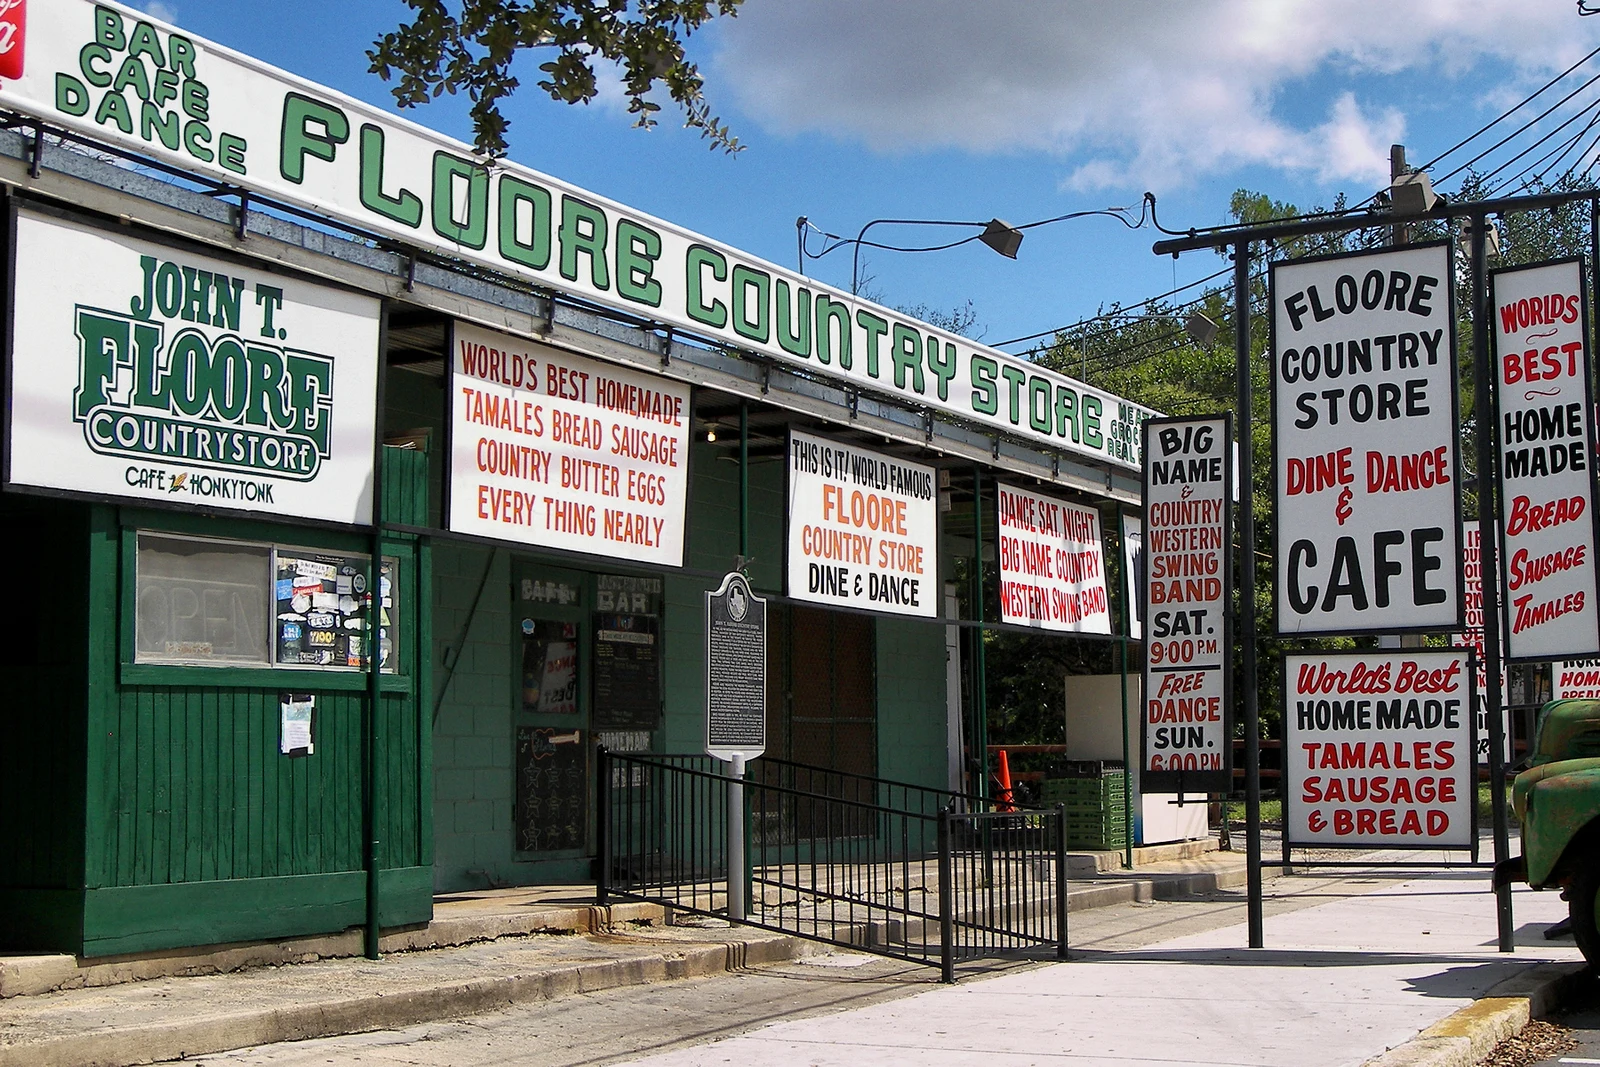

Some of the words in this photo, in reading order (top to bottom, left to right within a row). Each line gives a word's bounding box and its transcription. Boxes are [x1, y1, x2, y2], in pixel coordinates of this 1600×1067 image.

[95, 4, 196, 78] BAR
[80, 42, 209, 121] CAFE
[56, 72, 247, 175] DANCE
[280, 92, 662, 307] FLOORE
[686, 243, 957, 403] COUNTRY
[971, 354, 1103, 450] STORE
[130, 254, 245, 331] JOHN
[256, 284, 287, 340] T.
[1284, 269, 1438, 332] FLOORE
[1500, 293, 1580, 334] WORLDS
[1281, 329, 1443, 384] COUNTRY
[1503, 341, 1582, 385] BEST
[75, 306, 334, 459] FLOORE
[460, 340, 538, 391] WORLD'S
[547, 363, 589, 404] BEST
[596, 376, 683, 427] HOMEMADE
[1294, 379, 1430, 430] STORE
[463, 387, 544, 437] TAMALES
[552, 410, 602, 451] BREAD
[611, 424, 678, 467] SAUSAGE
[1159, 426, 1213, 456] BIG
[1504, 402, 1583, 445] HOME
[125, 466, 165, 492] CAFE
[477, 437, 551, 484] COUNTRY
[561, 455, 620, 498] BUTTER
[627, 470, 666, 506] EGGS
[793, 439, 818, 474] THIS
[821, 446, 832, 478] IS
[834, 451, 850, 482] IT!
[851, 454, 887, 490] WORLD
[890, 464, 931, 501] FAMOUS
[1152, 458, 1222, 486] NAME
[1286, 447, 1354, 496] DINE
[1367, 445, 1450, 494] DANCE
[1505, 441, 1586, 480] MADE
[823, 484, 907, 536] FLOORE
[1150, 499, 1223, 527] COUNTRY
[1181, 485, 1194, 500] &
[1336, 486, 1353, 525] &
[478, 485, 536, 526] EVERY
[544, 497, 595, 537] THING
[604, 508, 664, 548] NEARLY
[1000, 491, 1036, 533] DANCE
[1063, 507, 1095, 546] NIGHT
[802, 524, 872, 565] COUNTRY
[879, 540, 924, 575] STORE
[1001, 535, 1019, 573] BIG
[1022, 542, 1053, 578] NAME
[1056, 548, 1099, 584] COUNTRY
[1150, 527, 1222, 553] WESTERN
[808, 563, 848, 597] DINE
[853, 573, 863, 596] &
[869, 573, 919, 607] DANCE
[1152, 551, 1218, 579] SWING
[1288, 527, 1447, 615] CAFE
[597, 591, 648, 613] BAR
[1000, 580, 1050, 621] WESTERN
[1052, 587, 1082, 624] SWING
[1081, 586, 1106, 617] BAND
[1150, 577, 1221, 604] BAND
[1153, 609, 1214, 639] SAT.
[1150, 639, 1194, 664] 9:00
[1157, 672, 1206, 699] FREE
[1297, 661, 1391, 694] World's
[1394, 660, 1461, 694] Best
[1149, 697, 1221, 724] DANCE
[1154, 726, 1214, 750] SUN.
[1302, 741, 1455, 770] TAMALES
[1302, 776, 1457, 804] SAUSAGE
[1308, 810, 1327, 833] &
[1333, 809, 1449, 836] BREAD
